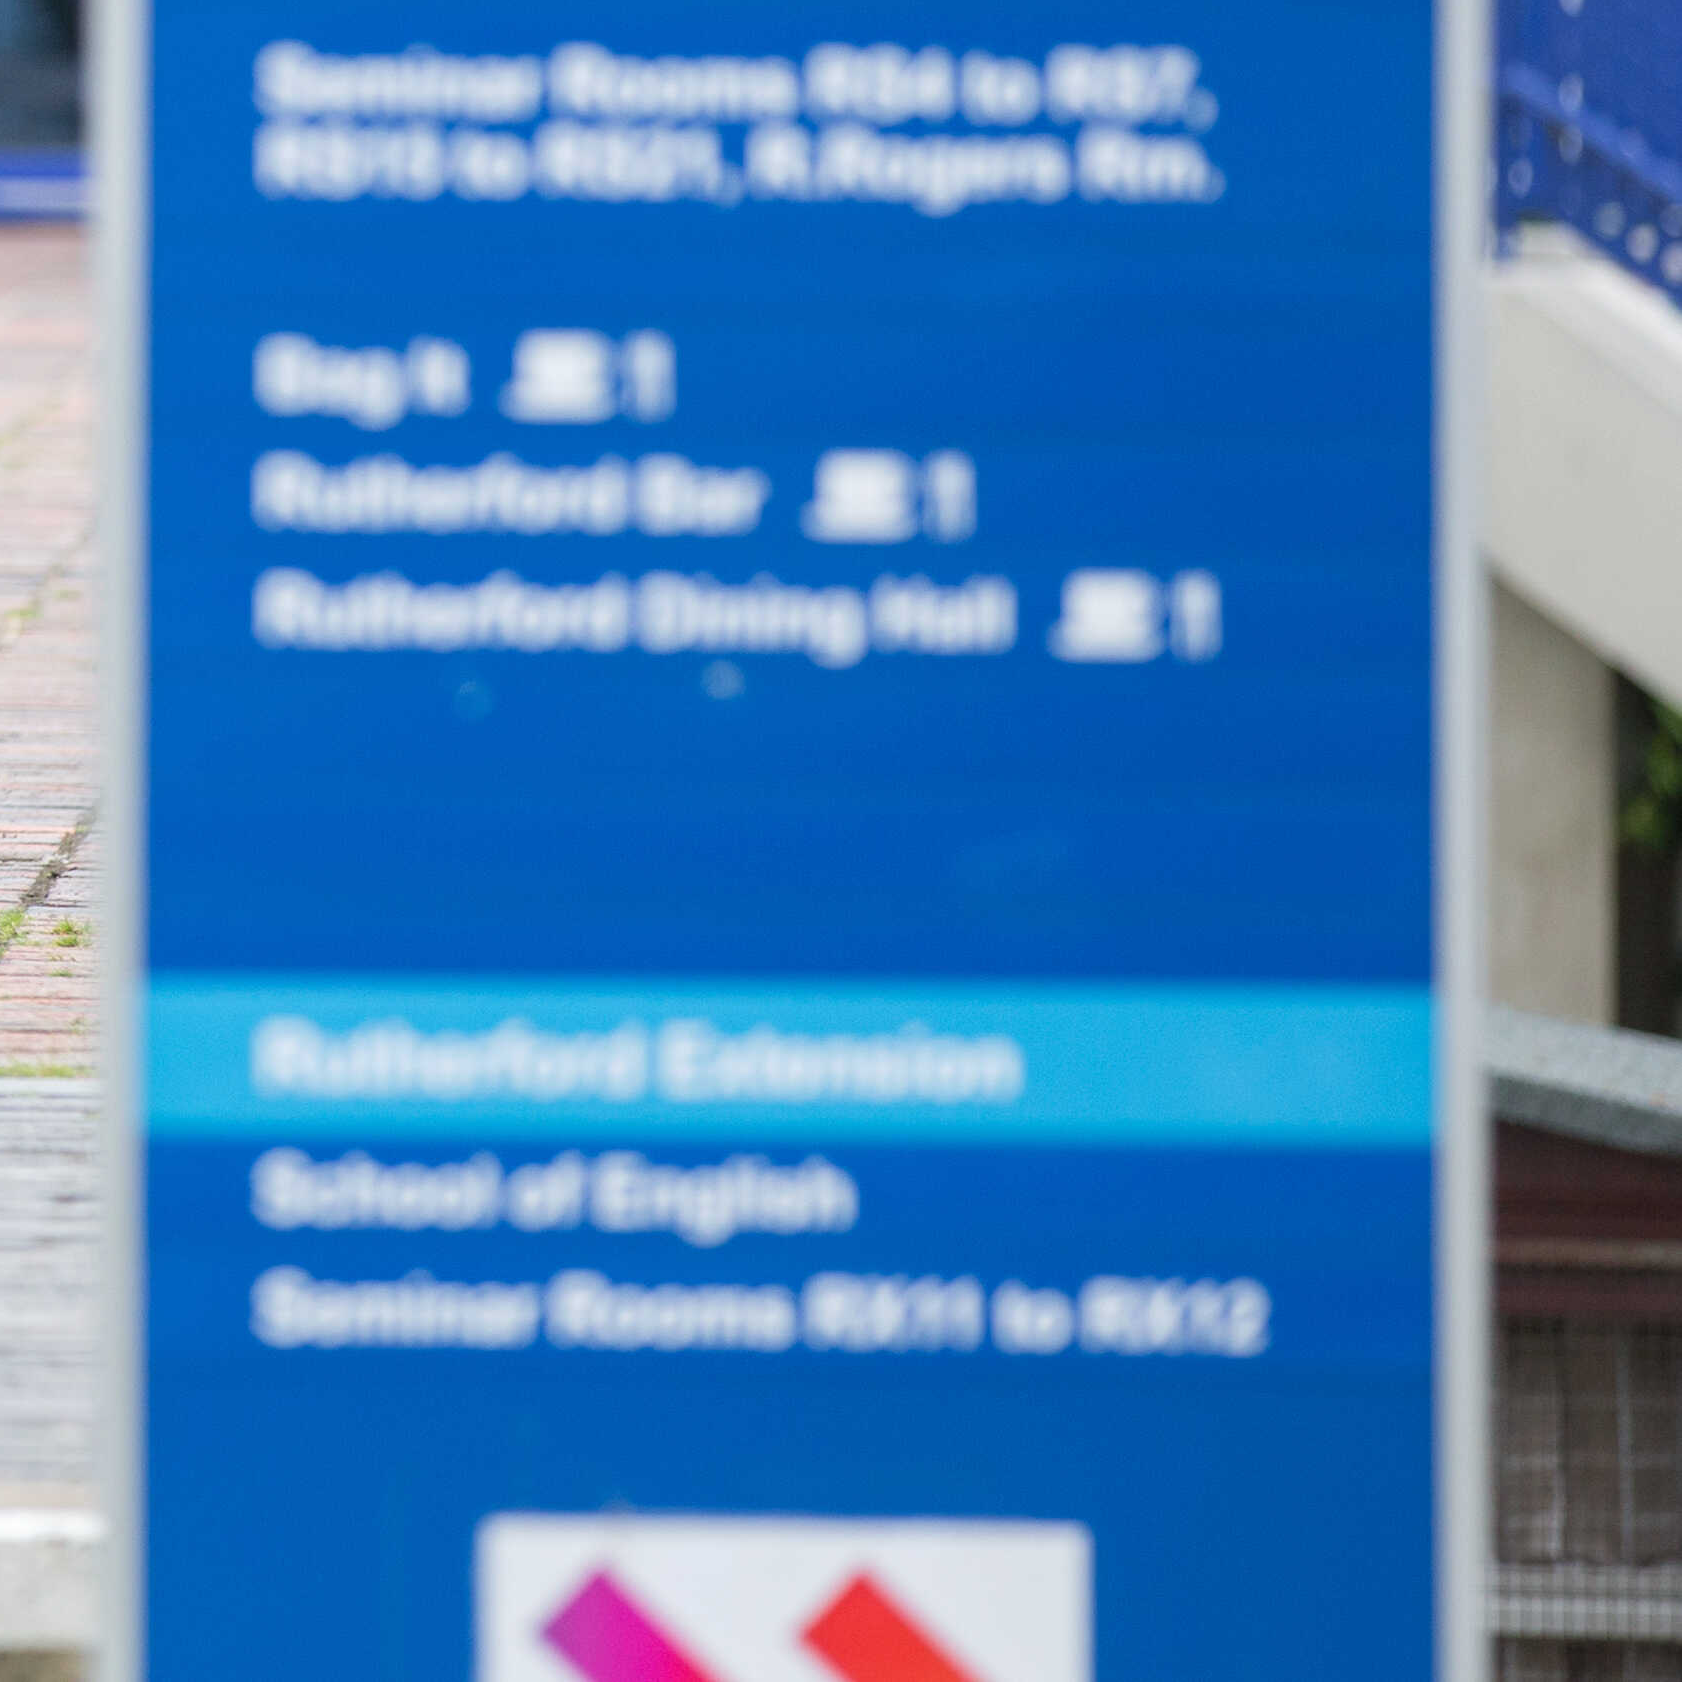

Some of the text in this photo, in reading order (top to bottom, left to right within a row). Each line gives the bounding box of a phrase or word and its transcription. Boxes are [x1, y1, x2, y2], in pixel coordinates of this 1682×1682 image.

[256, 43, 540, 118] Seminar
[548, 44, 796, 119] Rooms
[962, 53, 1039, 122] to
[451, 130, 528, 198] to
[253, 452, 629, 532] Rutherford
[635, 456, 764, 534] Bar
[255, 570, 629, 650] Rutherford
[635, 573, 865, 665] Dining
[874, 574, 1016, 652] Hall
[252, 1019, 1023, 1102] Rutherford Extension
[254, 1149, 856, 1244] School of English
[254, 1268, 537, 1347] Seminar
[543, 1271, 794, 1348] Rooms
[992, 1286, 1072, 1351] to
